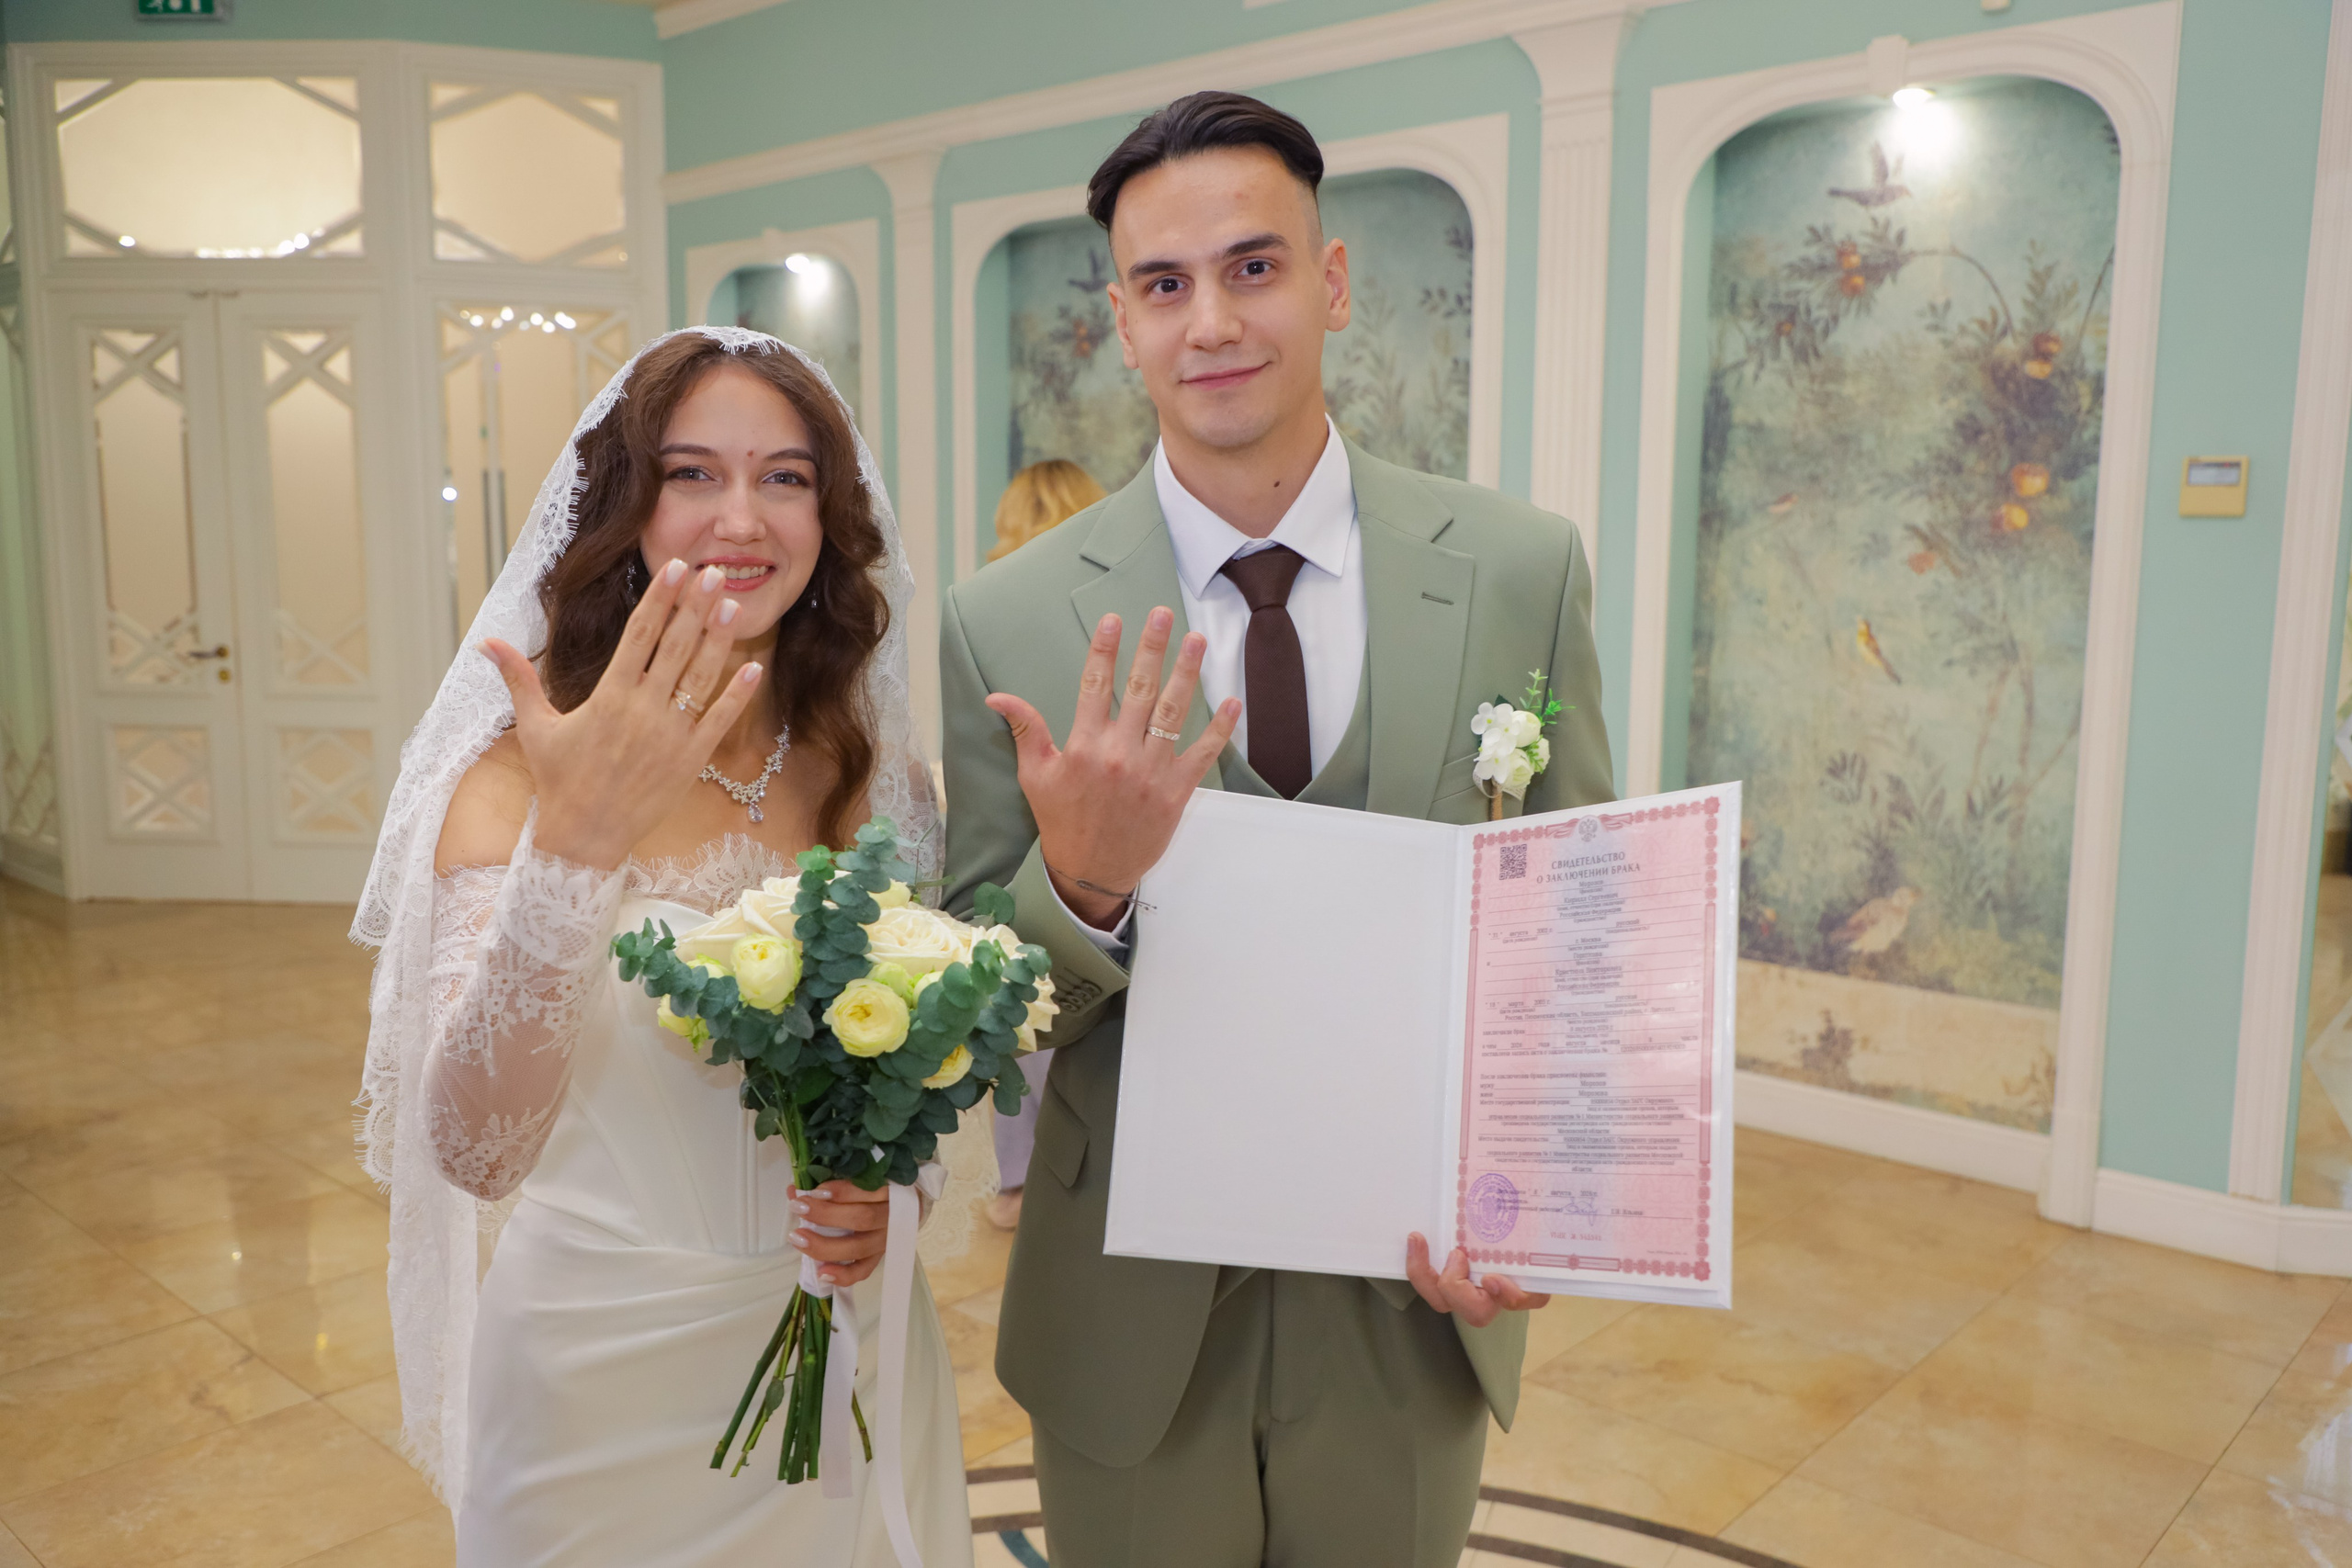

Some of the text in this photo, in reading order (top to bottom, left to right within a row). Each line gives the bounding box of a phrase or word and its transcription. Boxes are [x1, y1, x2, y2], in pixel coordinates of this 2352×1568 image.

[1551, 852, 1626, 869] СВИДЕТЕЛЬСТВО
[1536, 863, 1641, 884] О ЗАКЛЮЧЕНИИ БРАКА
